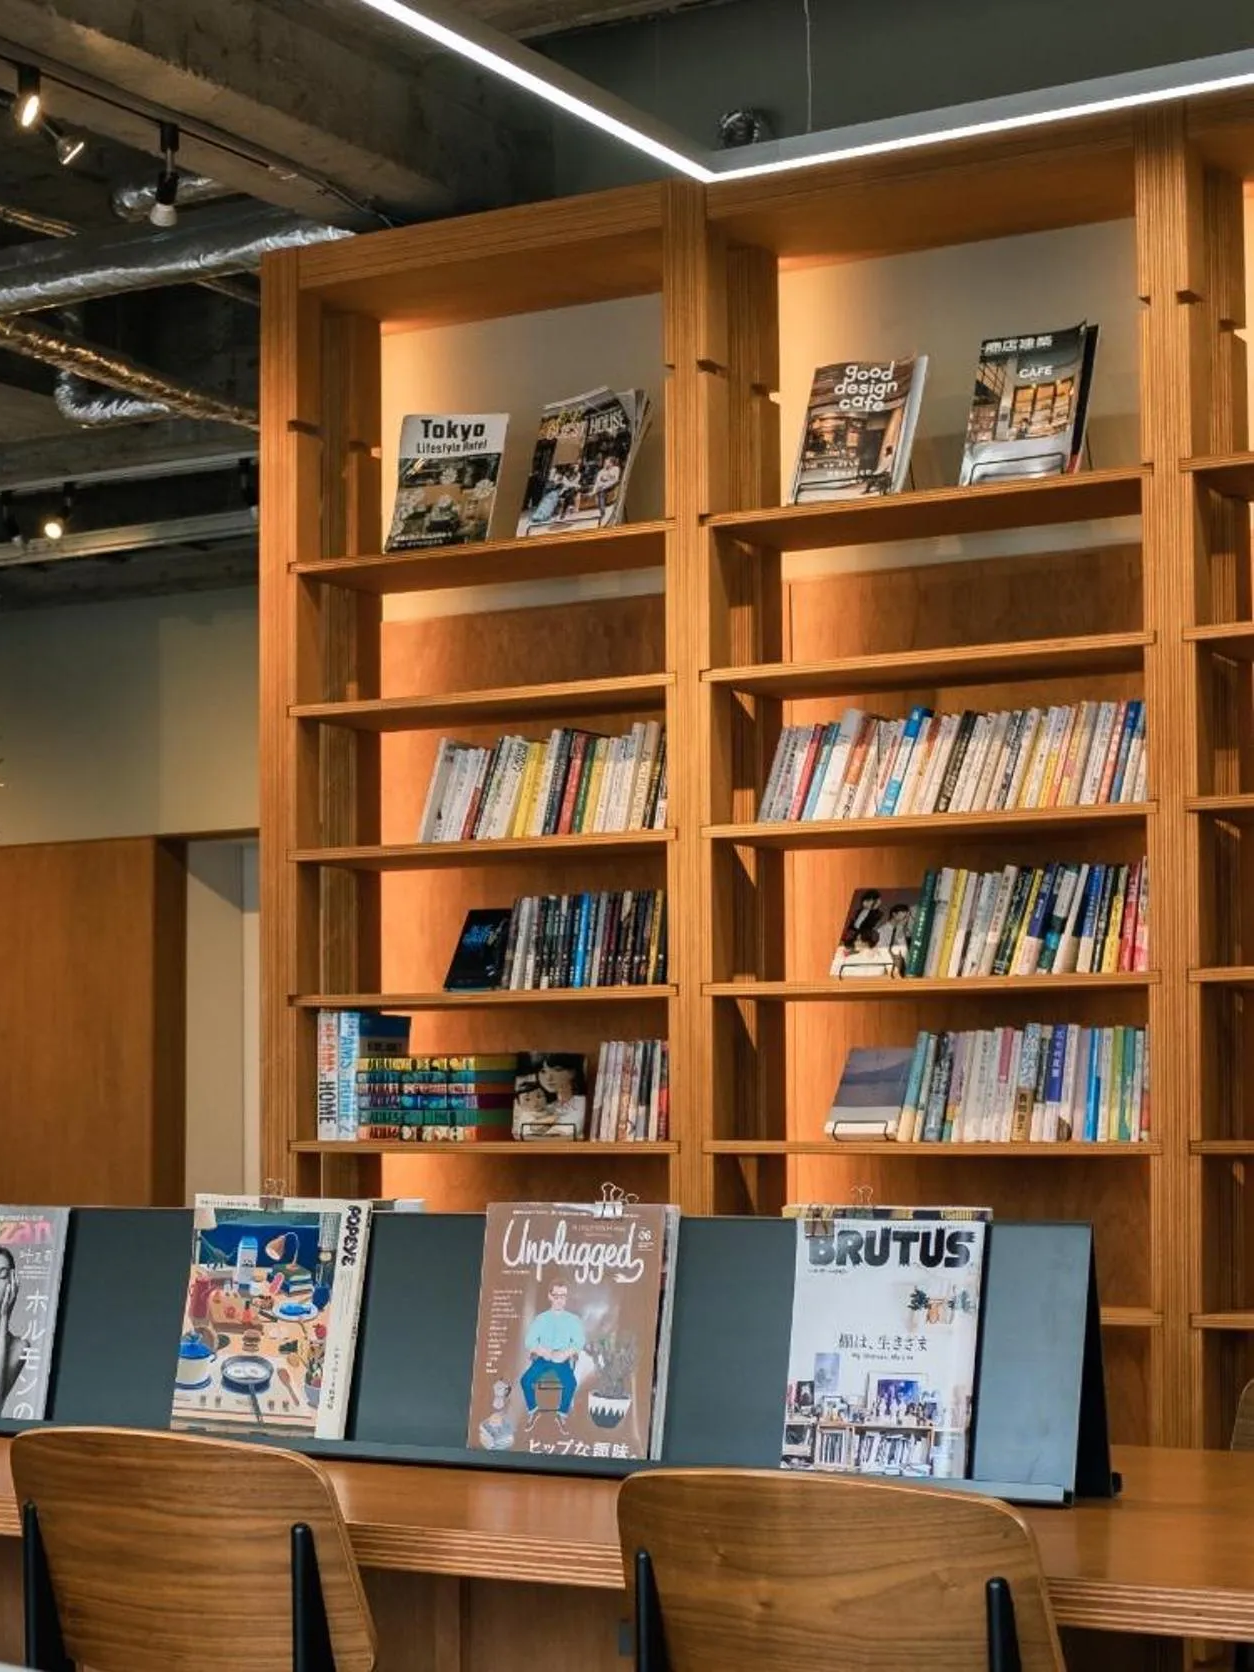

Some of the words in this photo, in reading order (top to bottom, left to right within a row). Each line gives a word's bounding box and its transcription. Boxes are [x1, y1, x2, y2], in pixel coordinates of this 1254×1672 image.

[834, 377, 898, 400] design
[845, 361, 896, 383] good
[839, 394, 885, 412] cafe
[420, 419, 486, 443] Tokyo
[318, 1081, 337, 1125] HOME
[340, 1204, 363, 1267] POPEYE
[503, 1218, 644, 1284] Unplugged
[808, 1226, 977, 1268] BRUTUS
[12, 1290, 50, 1419] ホルモンの
